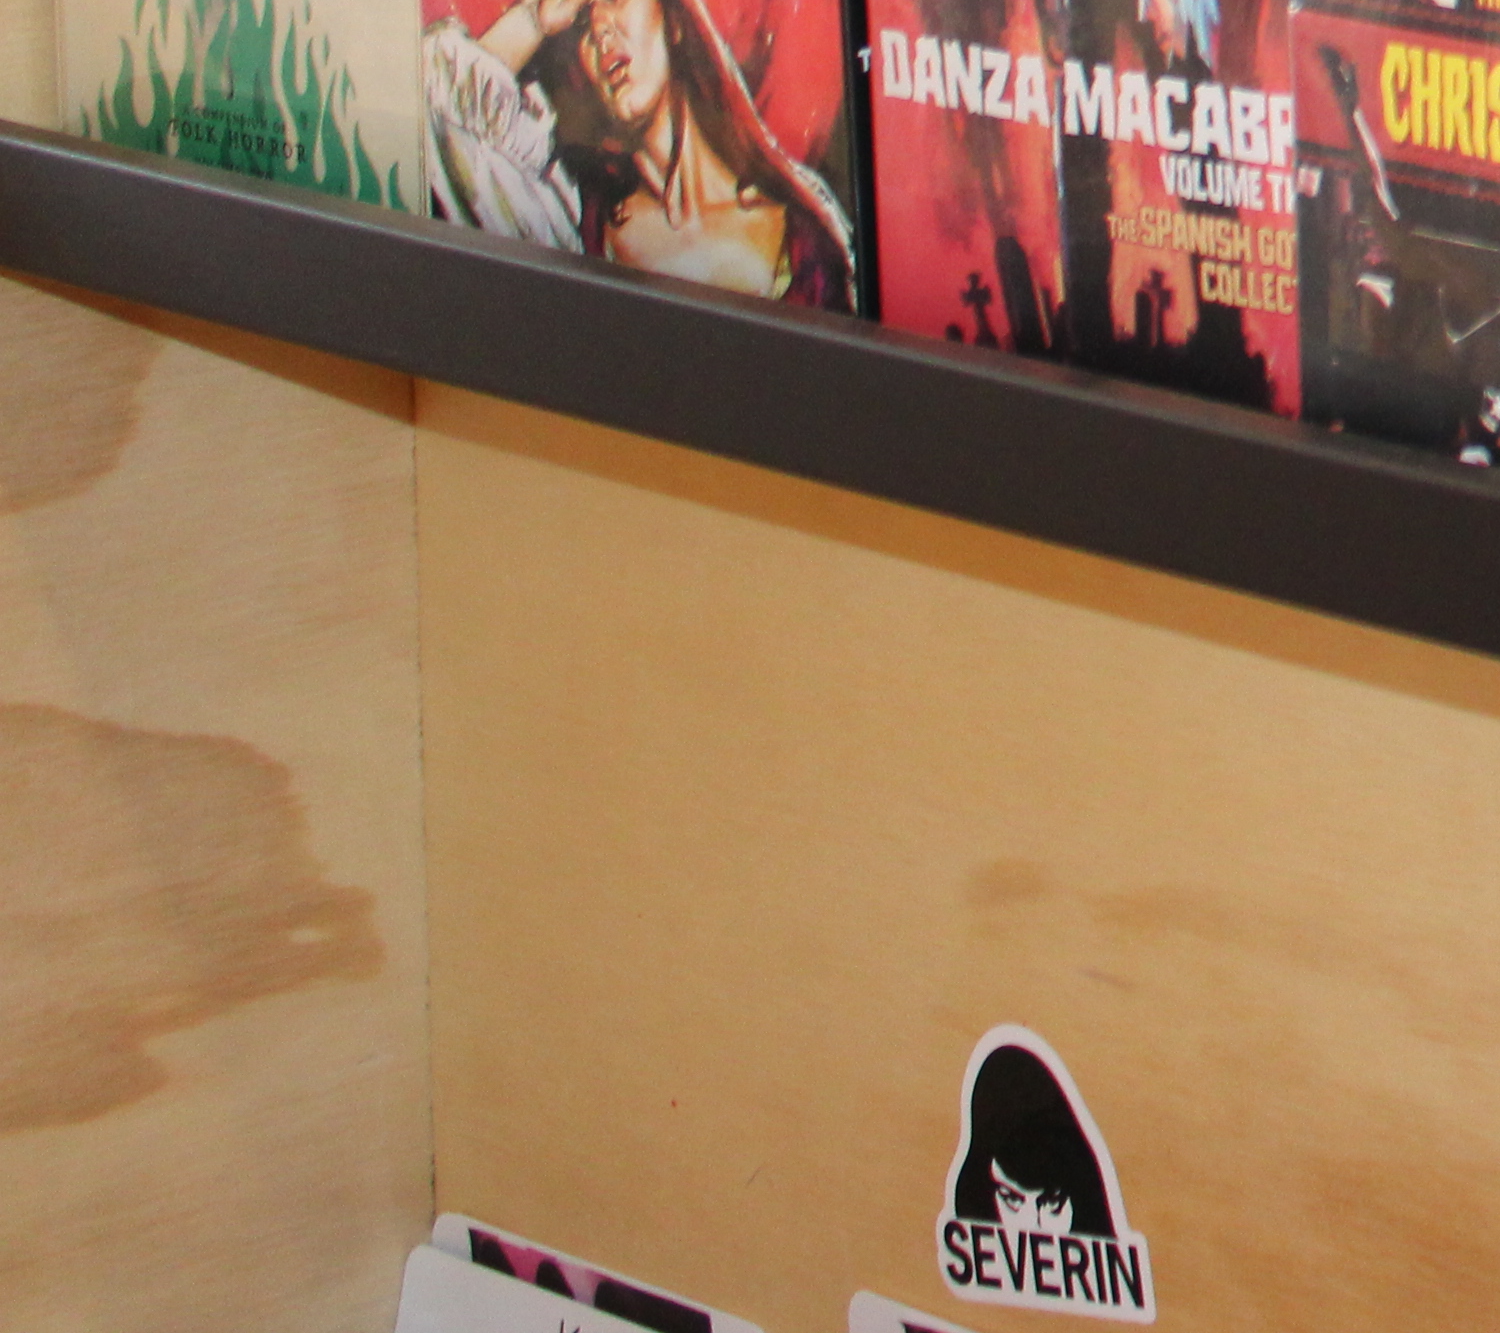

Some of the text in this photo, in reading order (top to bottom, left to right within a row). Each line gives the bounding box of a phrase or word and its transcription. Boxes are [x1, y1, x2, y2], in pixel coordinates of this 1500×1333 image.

[880, 29, 1052, 130] DANZA
[228, 130, 307, 165] HORROR
[1159, 153, 1265, 211] VOLUME
[1107, 206, 1253, 264] THE SPANISH
[944, 1220, 1147, 1309] SEVERIN
